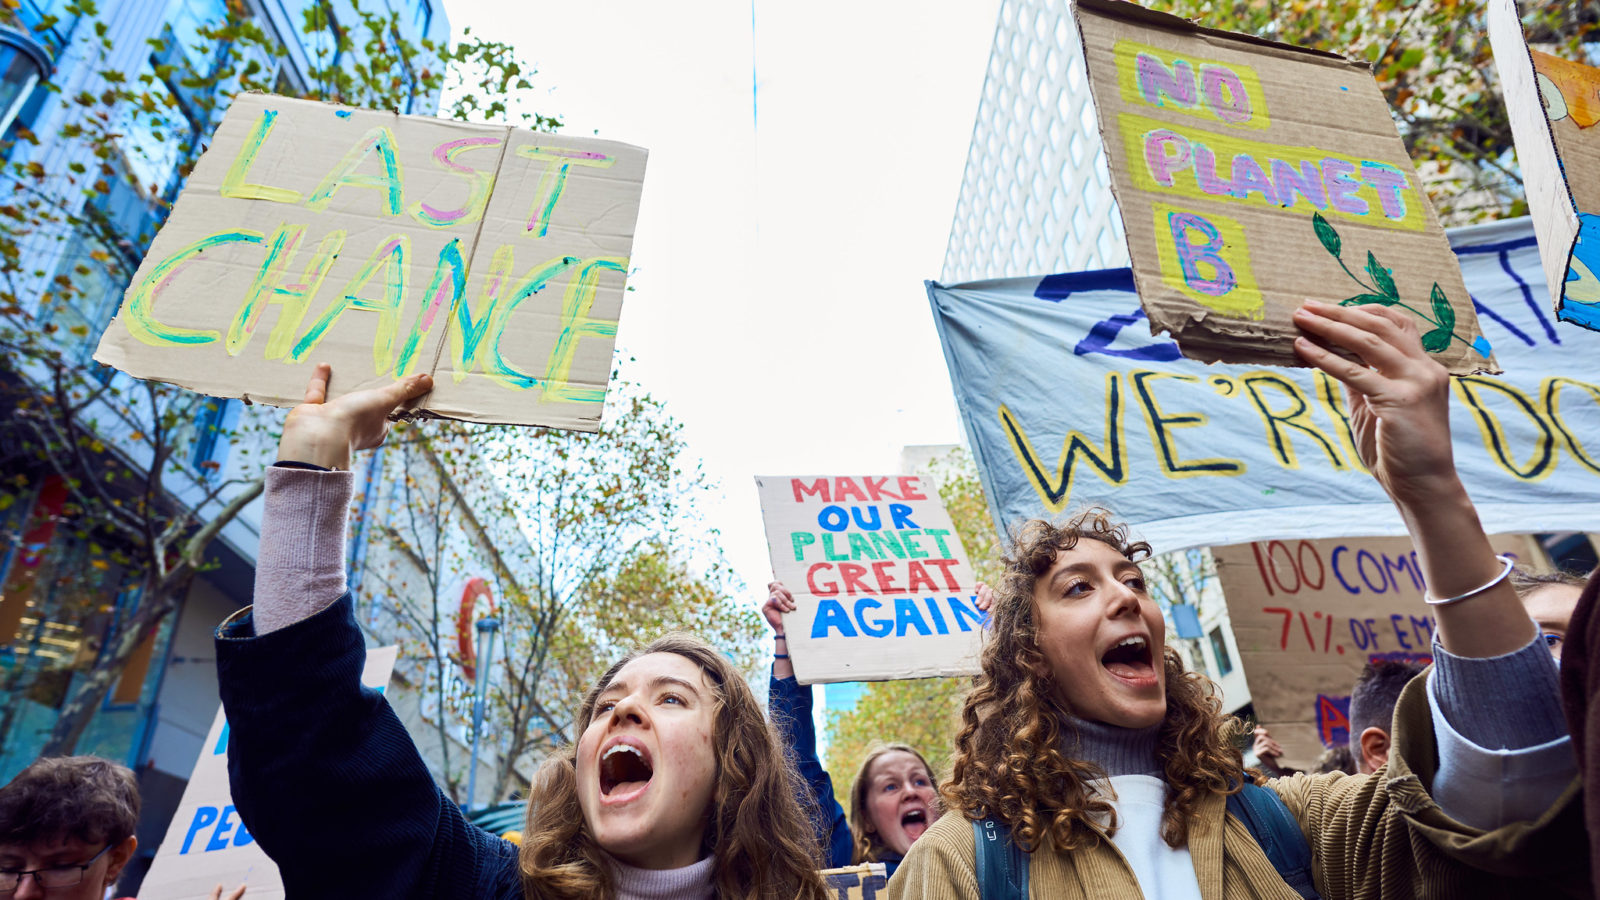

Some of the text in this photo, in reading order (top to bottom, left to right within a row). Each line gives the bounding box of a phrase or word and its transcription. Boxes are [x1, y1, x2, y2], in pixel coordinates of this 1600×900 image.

[1135, 52, 1254, 125] NO
[220, 109, 616, 238] LAST
[1141, 128, 1409, 220] PLANET
[1168, 211, 1238, 297] B
[122, 221, 628, 404] CHANCE
[790, 476, 928, 504] MAKE
[817, 503, 921, 533] OUR
[790, 527, 953, 563] PLANET
[1250, 539, 1325, 597] 100
[806, 558, 962, 598] GREAT
[810, 595, 992, 639] AGAIN
[1349, 617, 1379, 651] OF
[1390, 613, 1437, 650] EM
